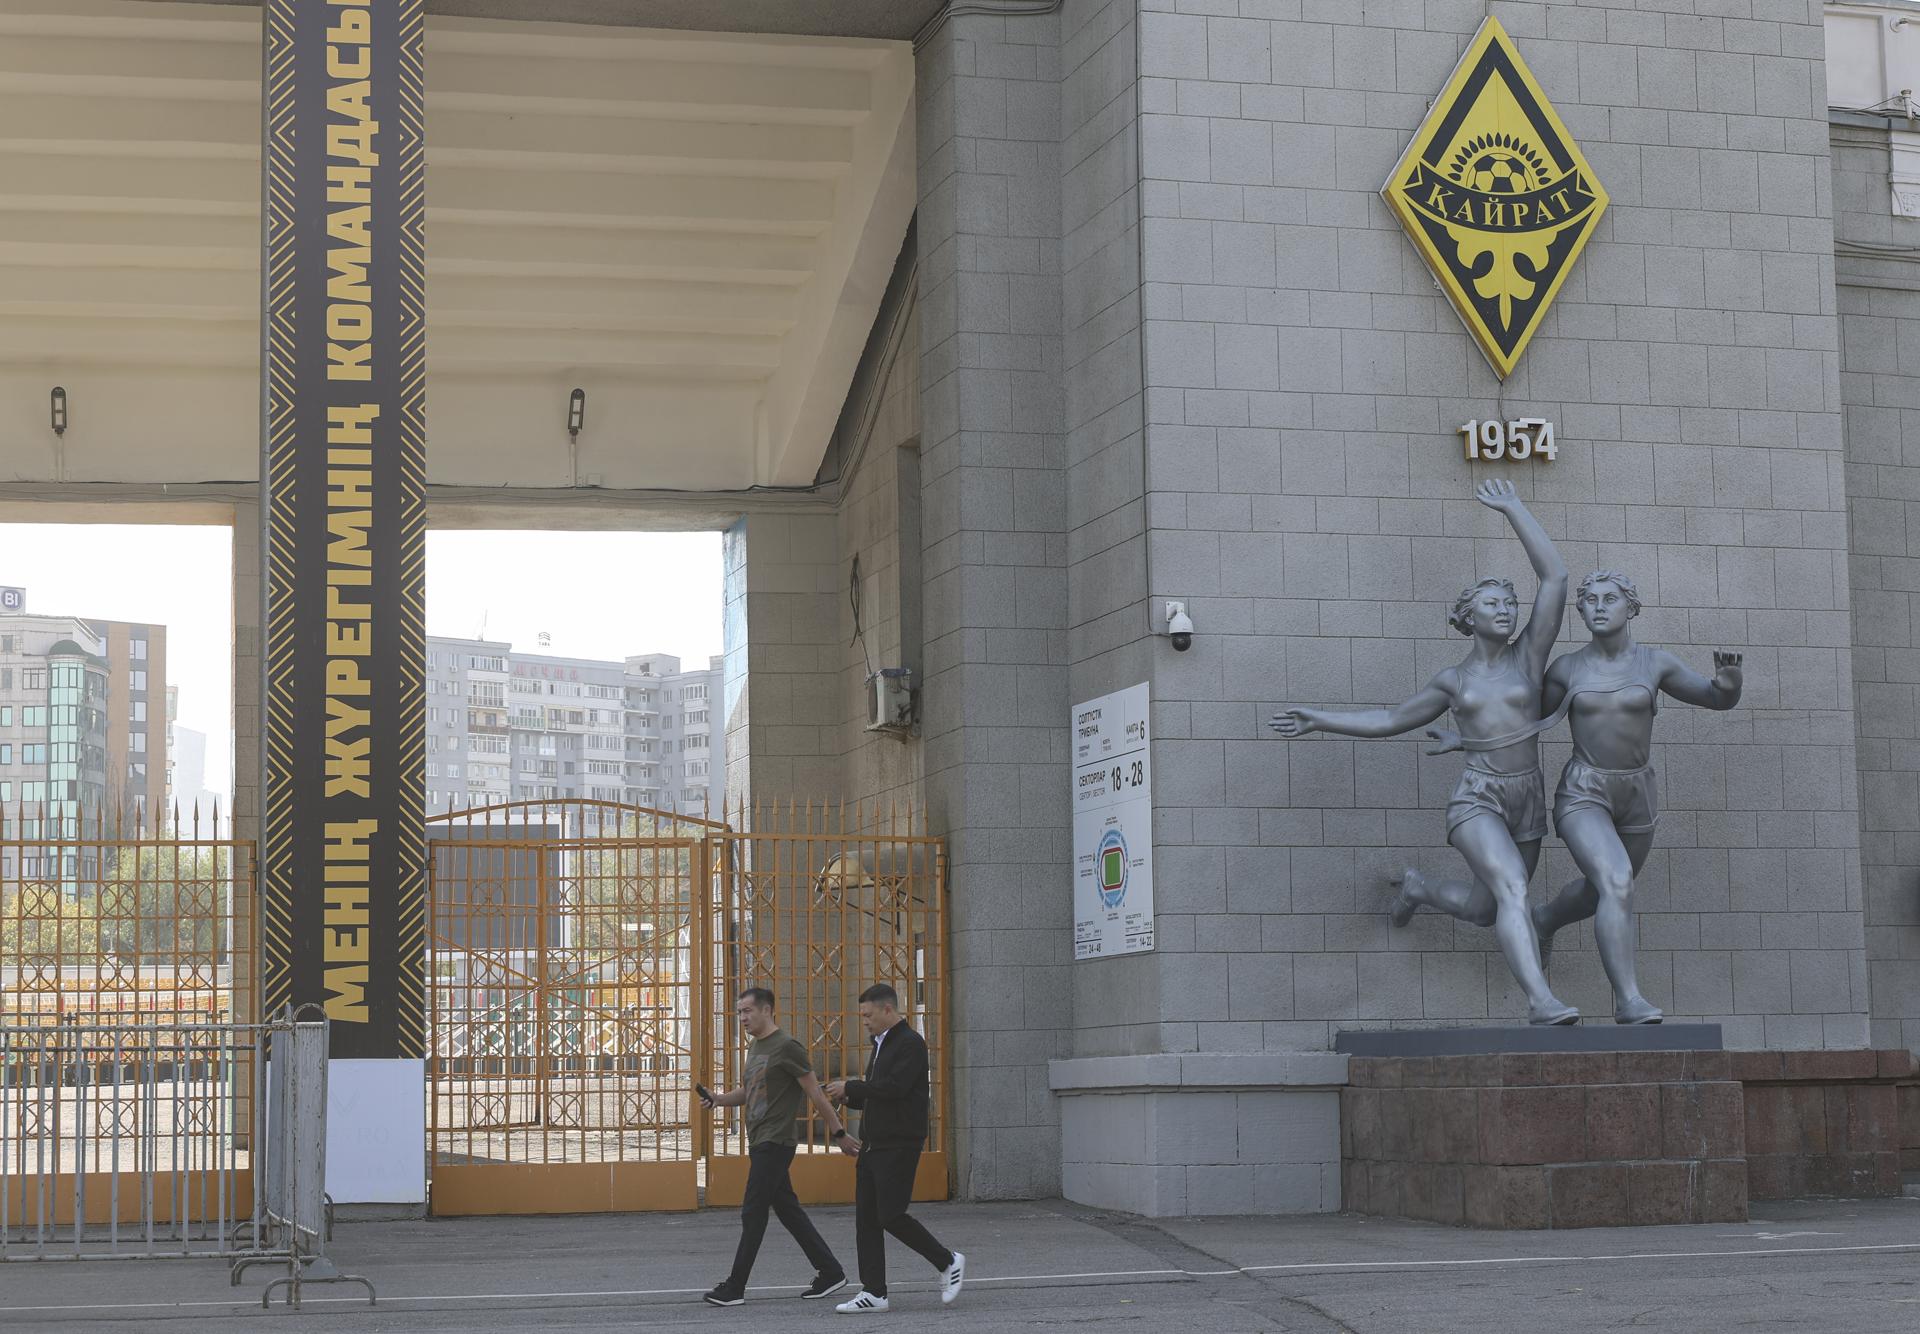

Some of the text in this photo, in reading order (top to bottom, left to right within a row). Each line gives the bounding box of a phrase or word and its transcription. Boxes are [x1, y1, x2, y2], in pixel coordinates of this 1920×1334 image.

[1424, 182, 1574, 227] ҚАЙРАТ
[1457, 418, 1559, 462] 1954
[323, 0, 380, 1023] МЕНІҢ ЖҮРЕГІМНІҢ КОМАНДАСЫ
[5, 592, 19, 606] BI
[1140, 720, 1145, 740] 6
[1111, 766, 1121, 791] 18
[1131, 760, 1143, 787] 28
